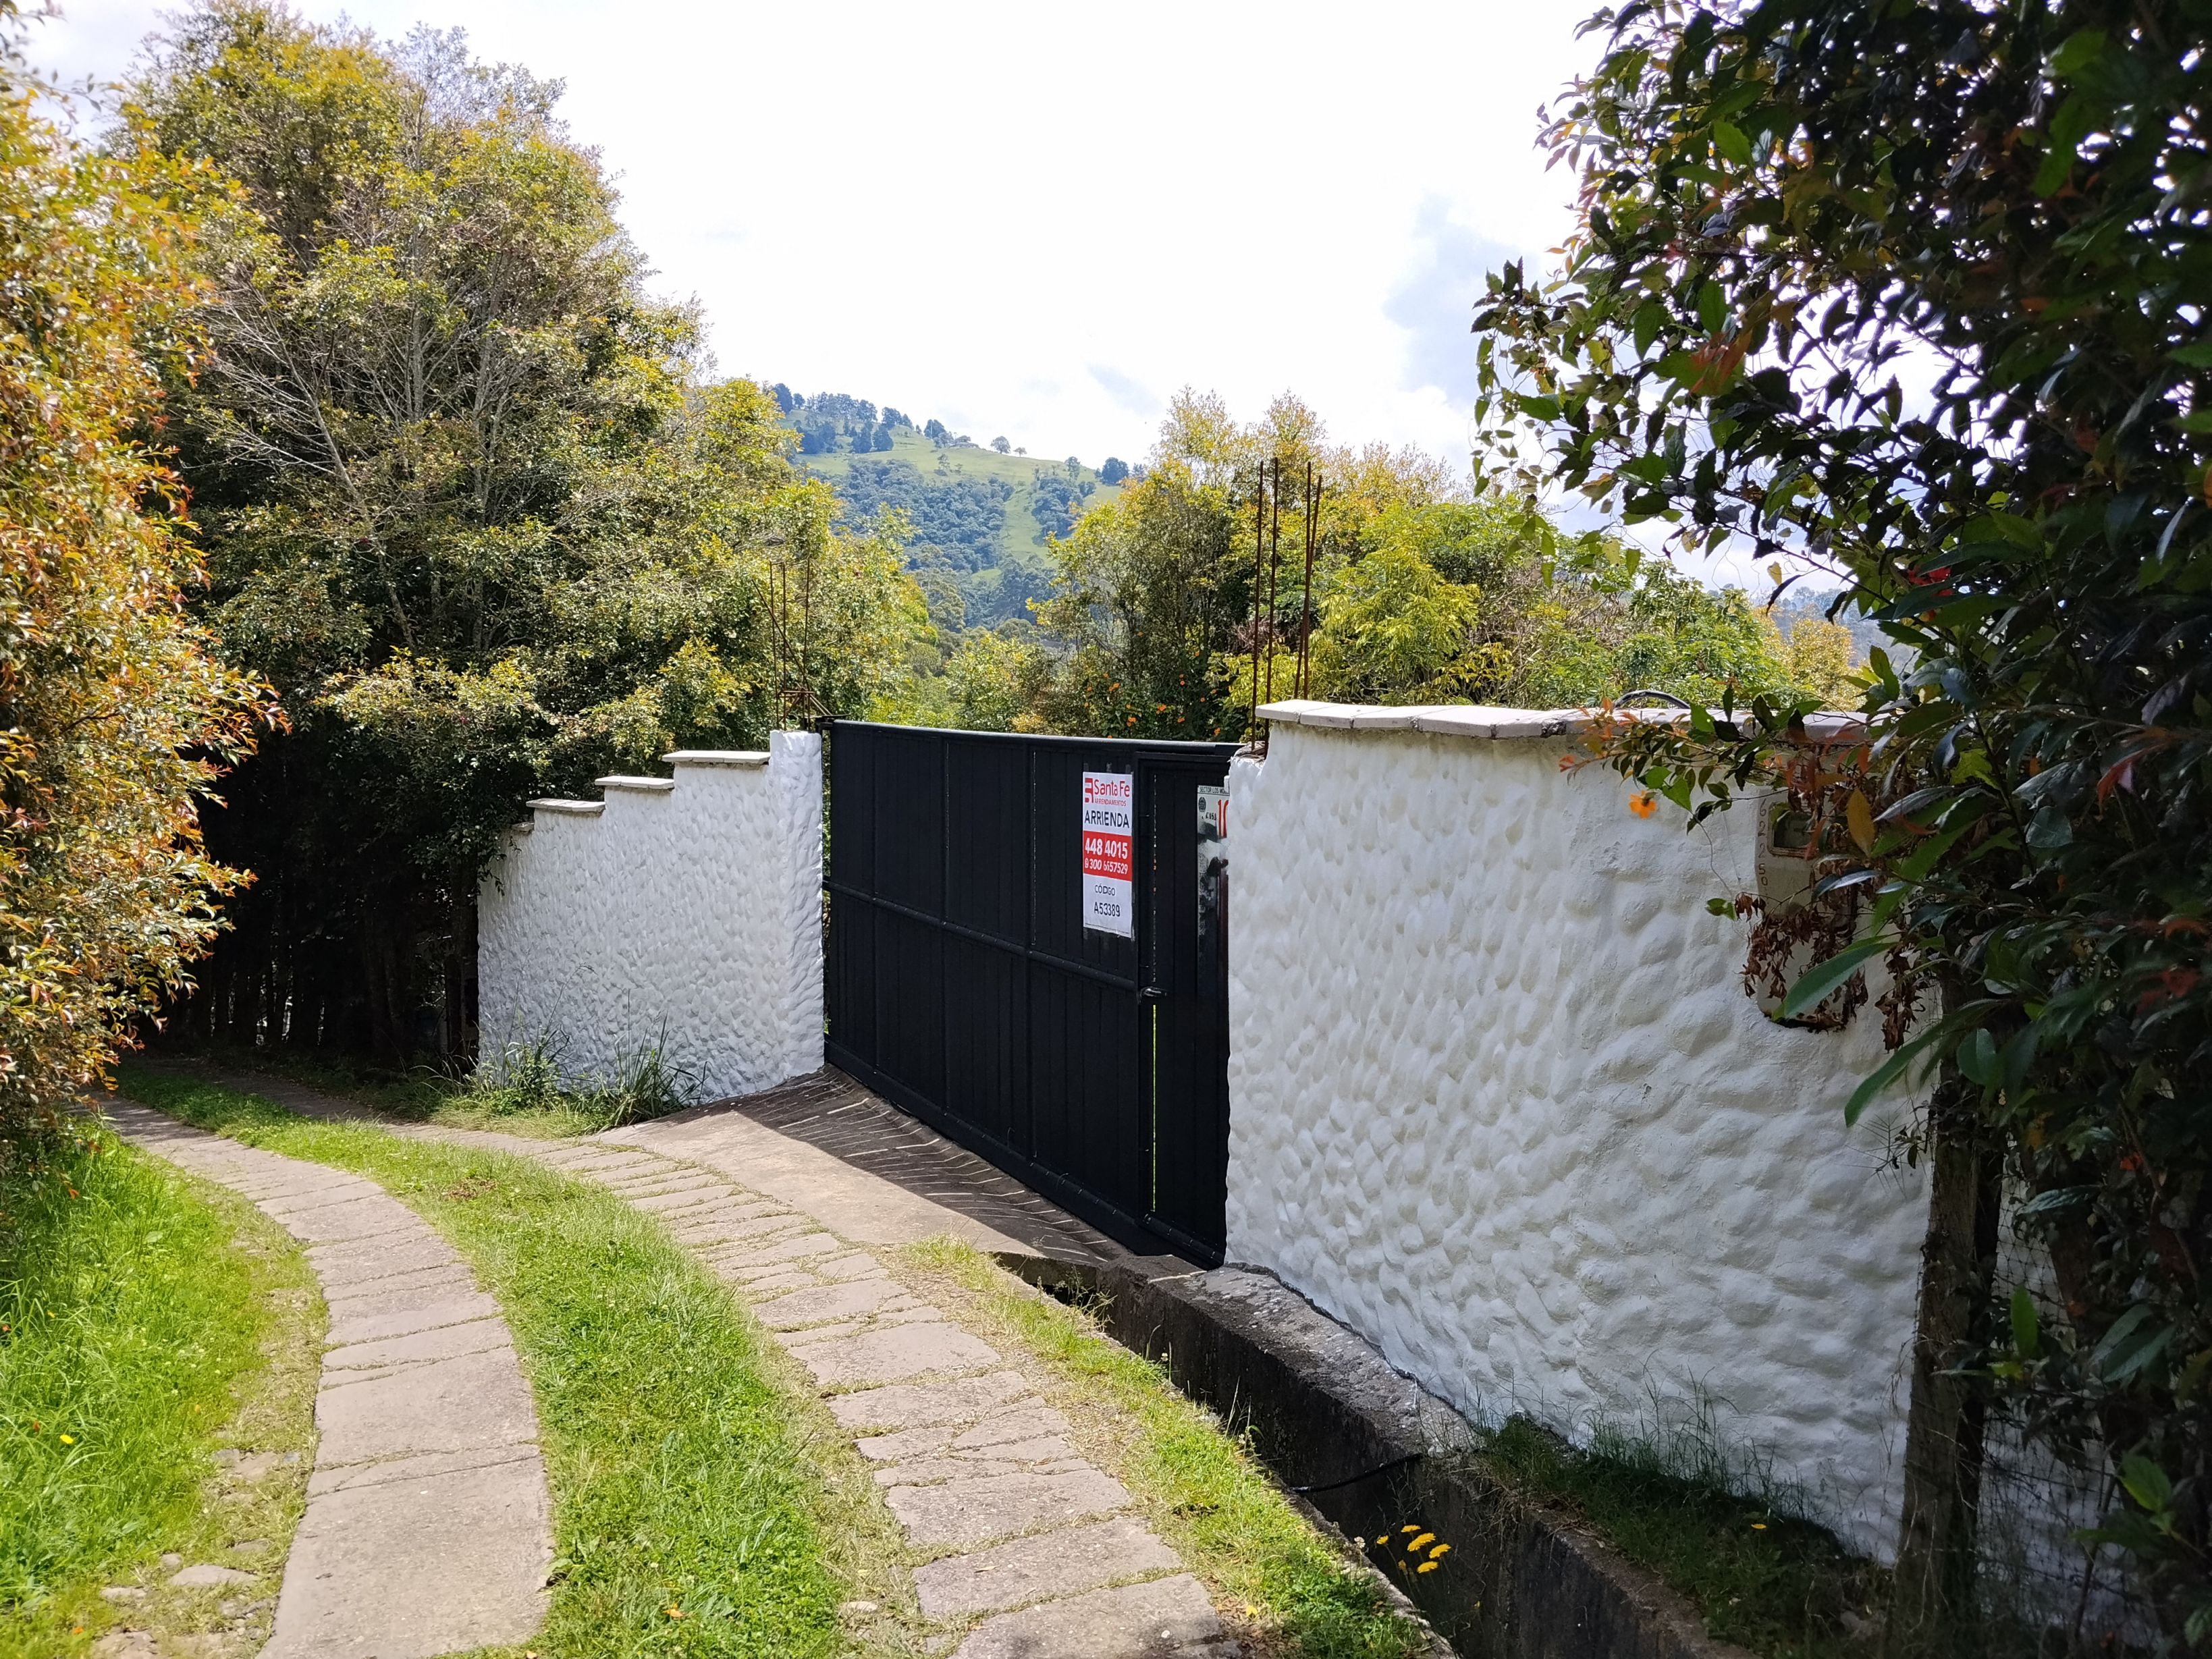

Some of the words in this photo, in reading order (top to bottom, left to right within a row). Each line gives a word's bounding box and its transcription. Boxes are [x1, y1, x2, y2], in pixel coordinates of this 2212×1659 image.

[1094, 779, 1118, 796] Santa
[1120, 781, 1130, 797] Fe
[1085, 810, 1130, 828] ARRIENDA
[1085, 838, 1103, 855] 448
[1104, 840, 1128, 859] 4015
[1089, 859, 1102, 871] 300
[1094, 902, 1121, 917] A53389
